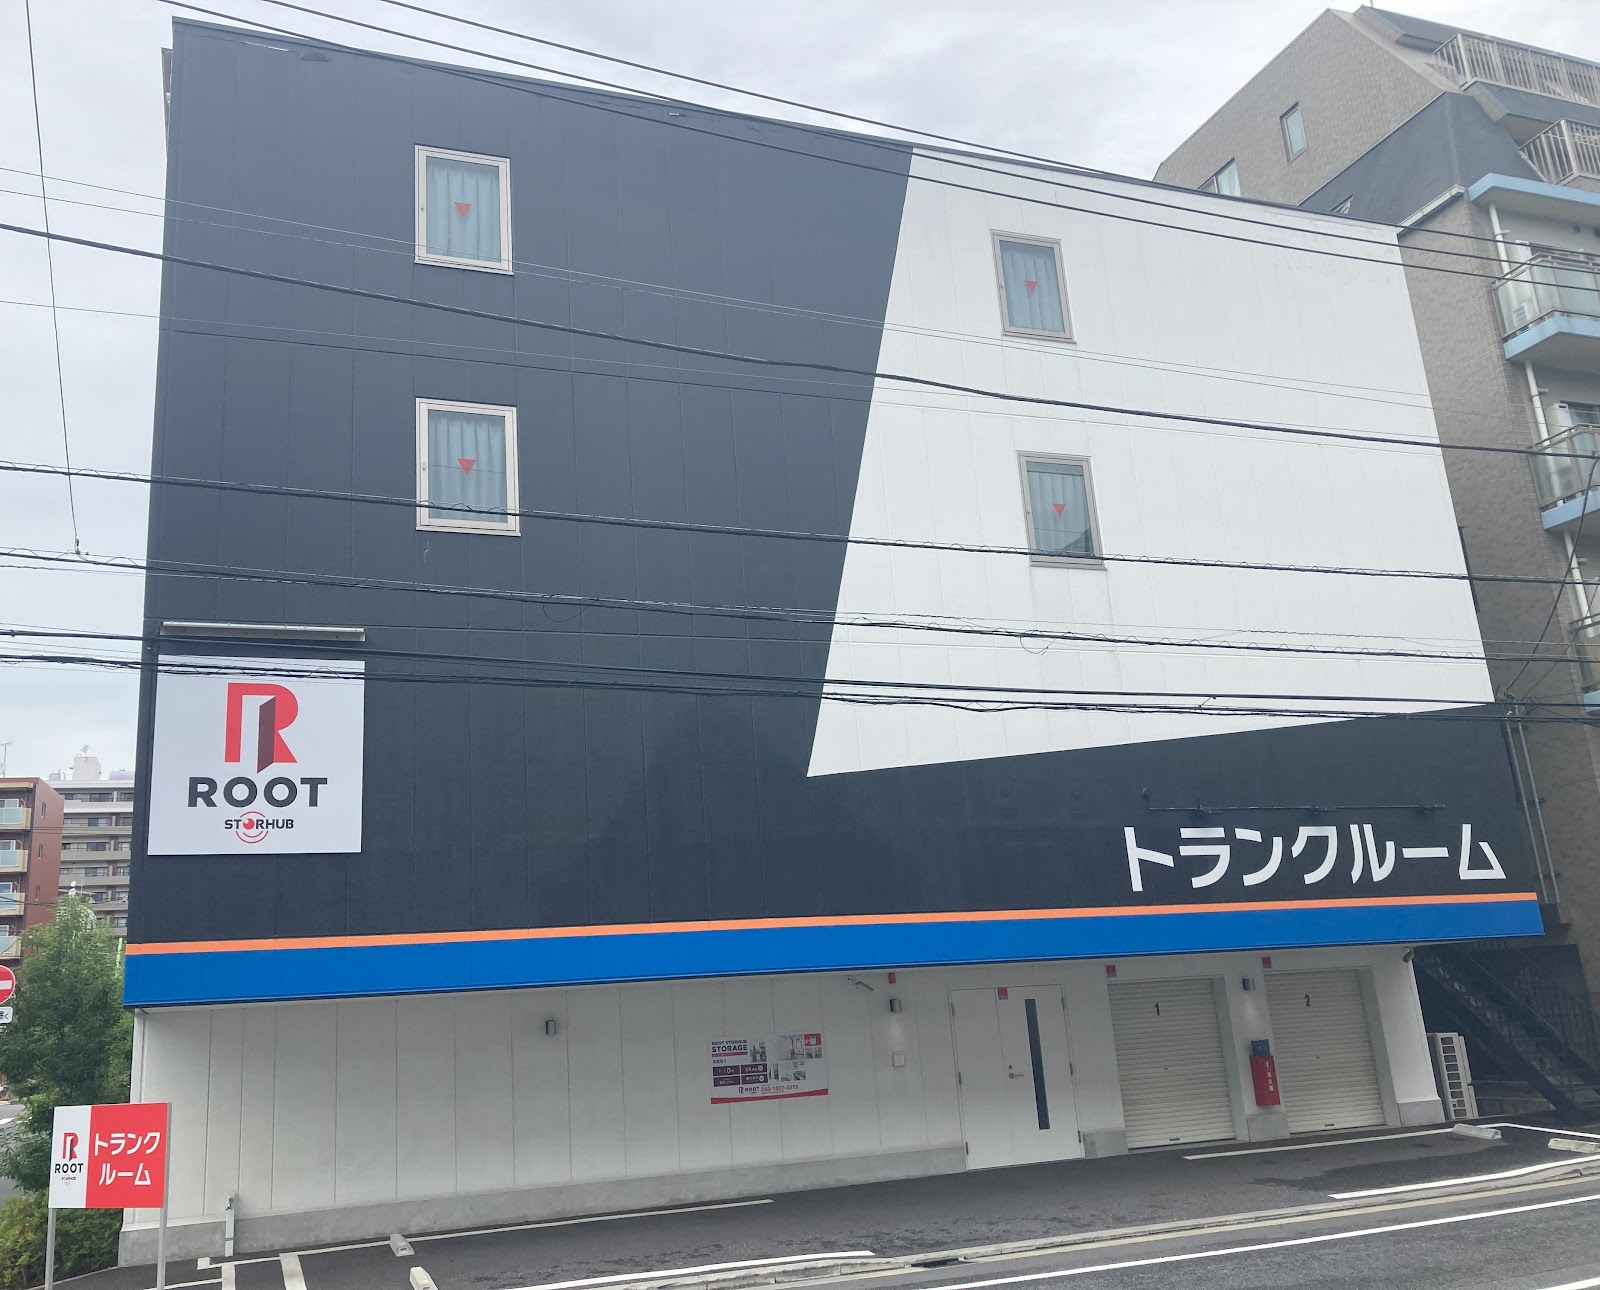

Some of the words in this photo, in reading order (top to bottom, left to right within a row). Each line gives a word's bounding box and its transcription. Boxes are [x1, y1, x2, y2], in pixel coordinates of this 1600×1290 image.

[187, 776, 328, 808] ROOT
[224, 818, 294, 830] STORHUB
[1123, 823, 1507, 892] トランクルーム
[1304, 994, 1311, 1007] 2
[1154, 1002, 1160, 1016] 1
[712, 1044, 748, 1052] STORAGE
[94, 1131, 161, 1157] トランク
[54, 1163, 84, 1174] ROOT
[98, 1162, 152, 1186] ルーム
